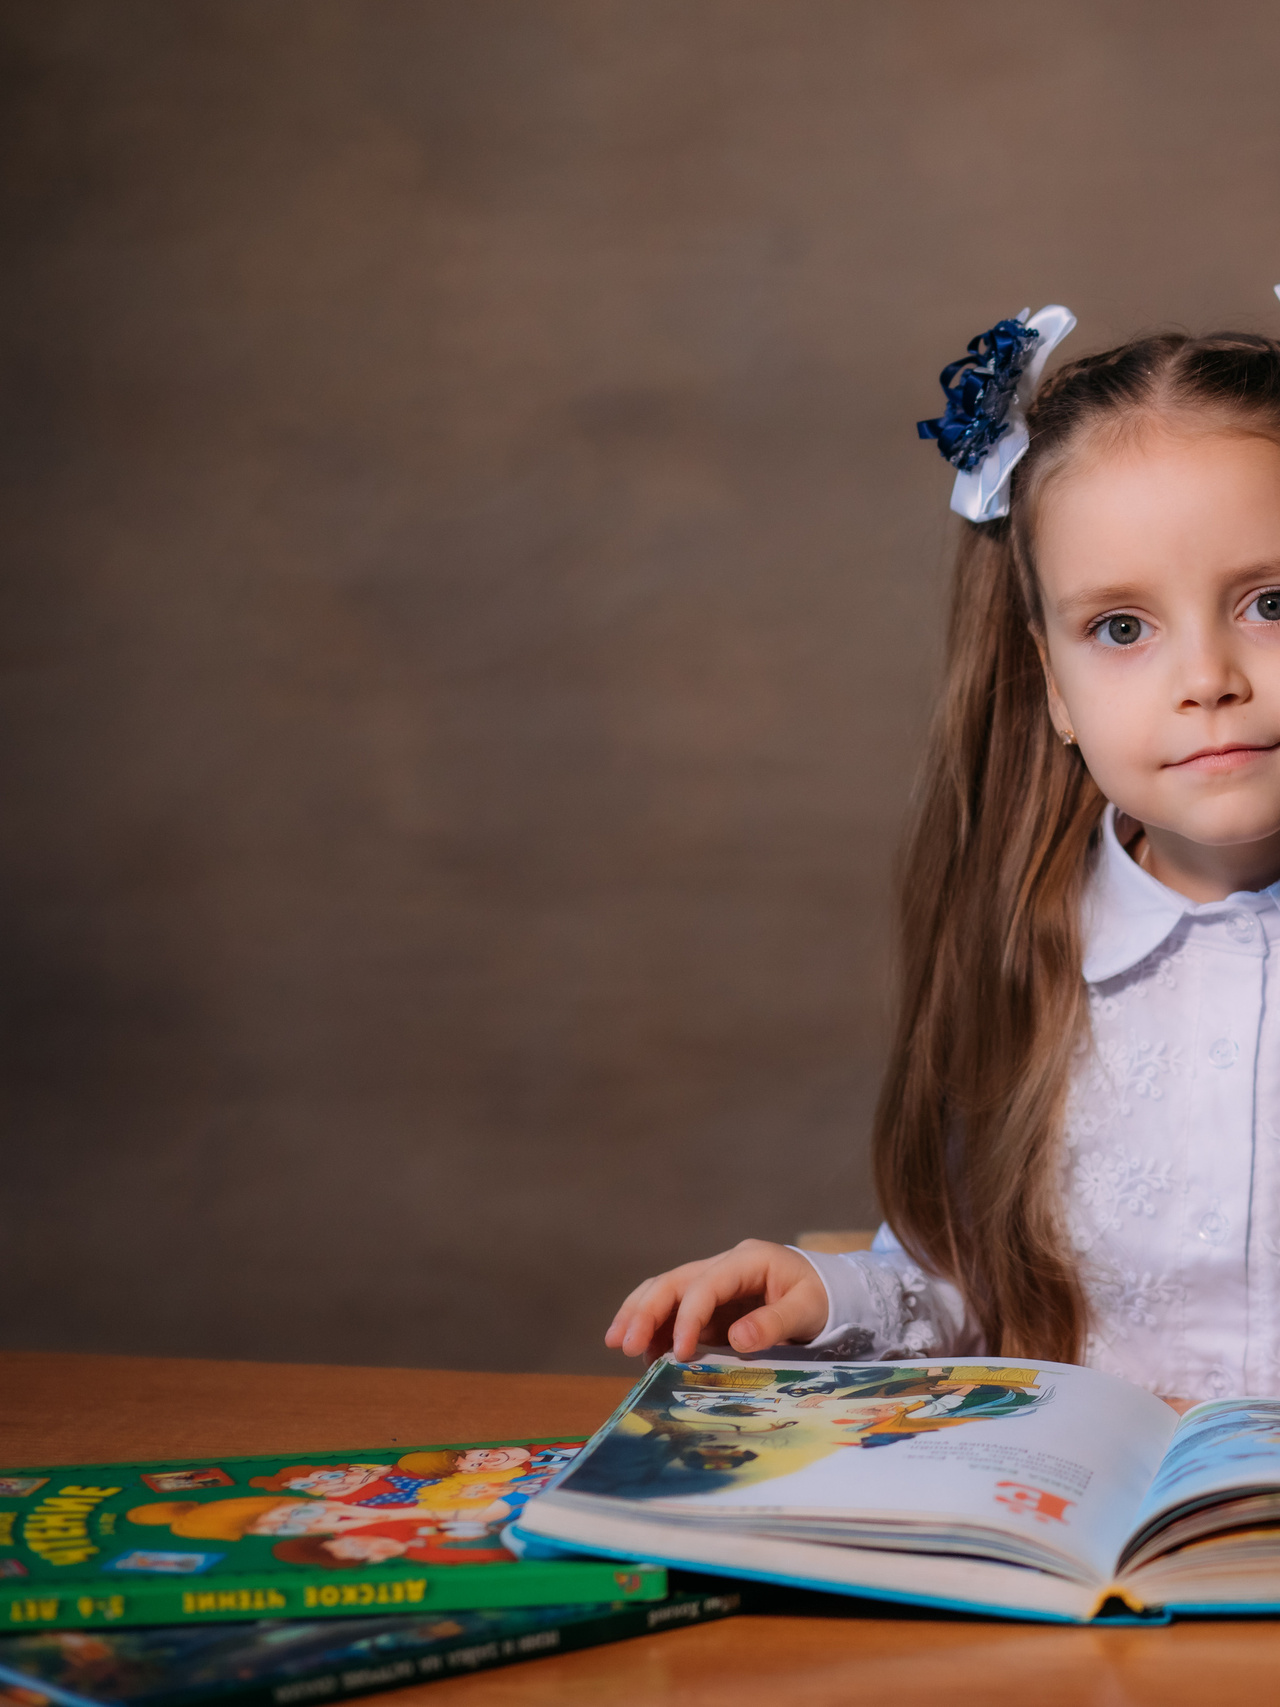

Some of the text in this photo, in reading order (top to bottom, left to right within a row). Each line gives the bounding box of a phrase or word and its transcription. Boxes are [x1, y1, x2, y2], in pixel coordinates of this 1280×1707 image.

[23, 1485, 123, 1566] ЧТЕНИЕ
[183, 1589, 286, 1613] ЧТЕНИЕ
[305, 1580, 427, 1607] ДЕТСКОЕ
[10, 1597, 58, 1622] ЛЕТ
